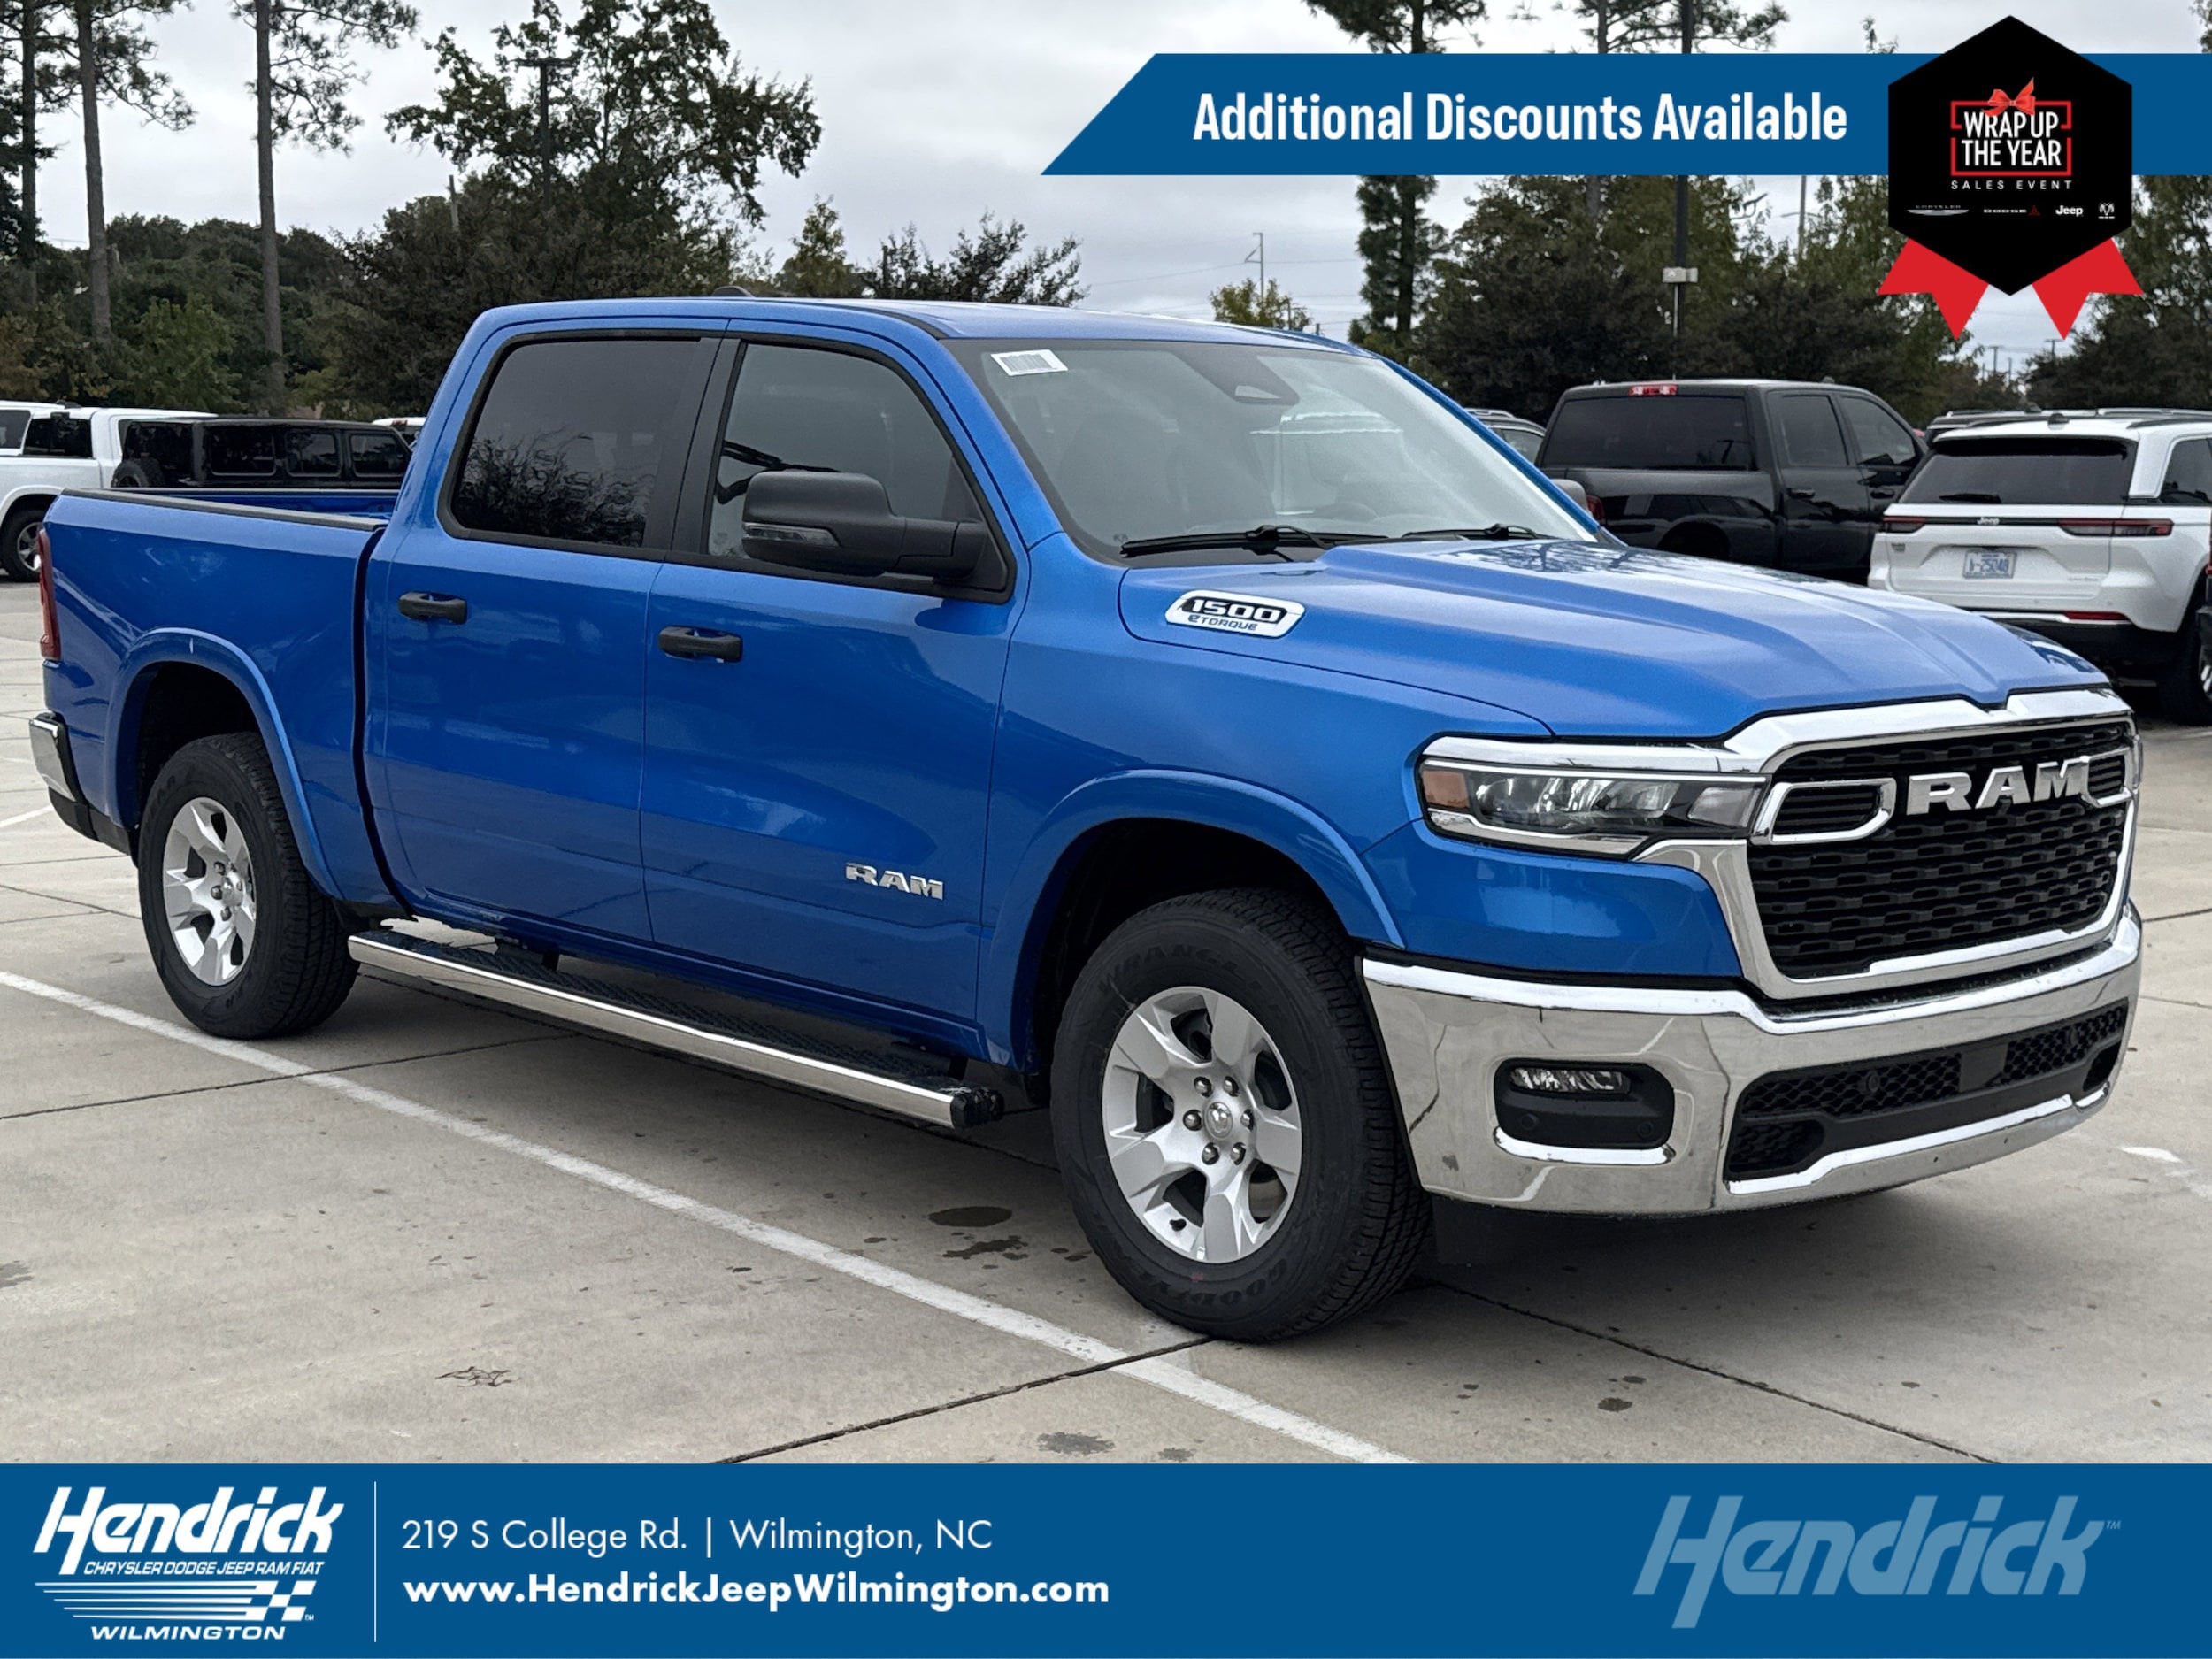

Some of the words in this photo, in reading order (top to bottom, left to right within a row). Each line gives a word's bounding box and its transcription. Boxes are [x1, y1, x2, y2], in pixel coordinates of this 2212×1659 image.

[1977, 517, 2000, 526] Jeep
[1191, 599, 1281, 623] 1500
[1906, 755, 2089, 816] RAM
[845, 862, 944, 901] RAM
